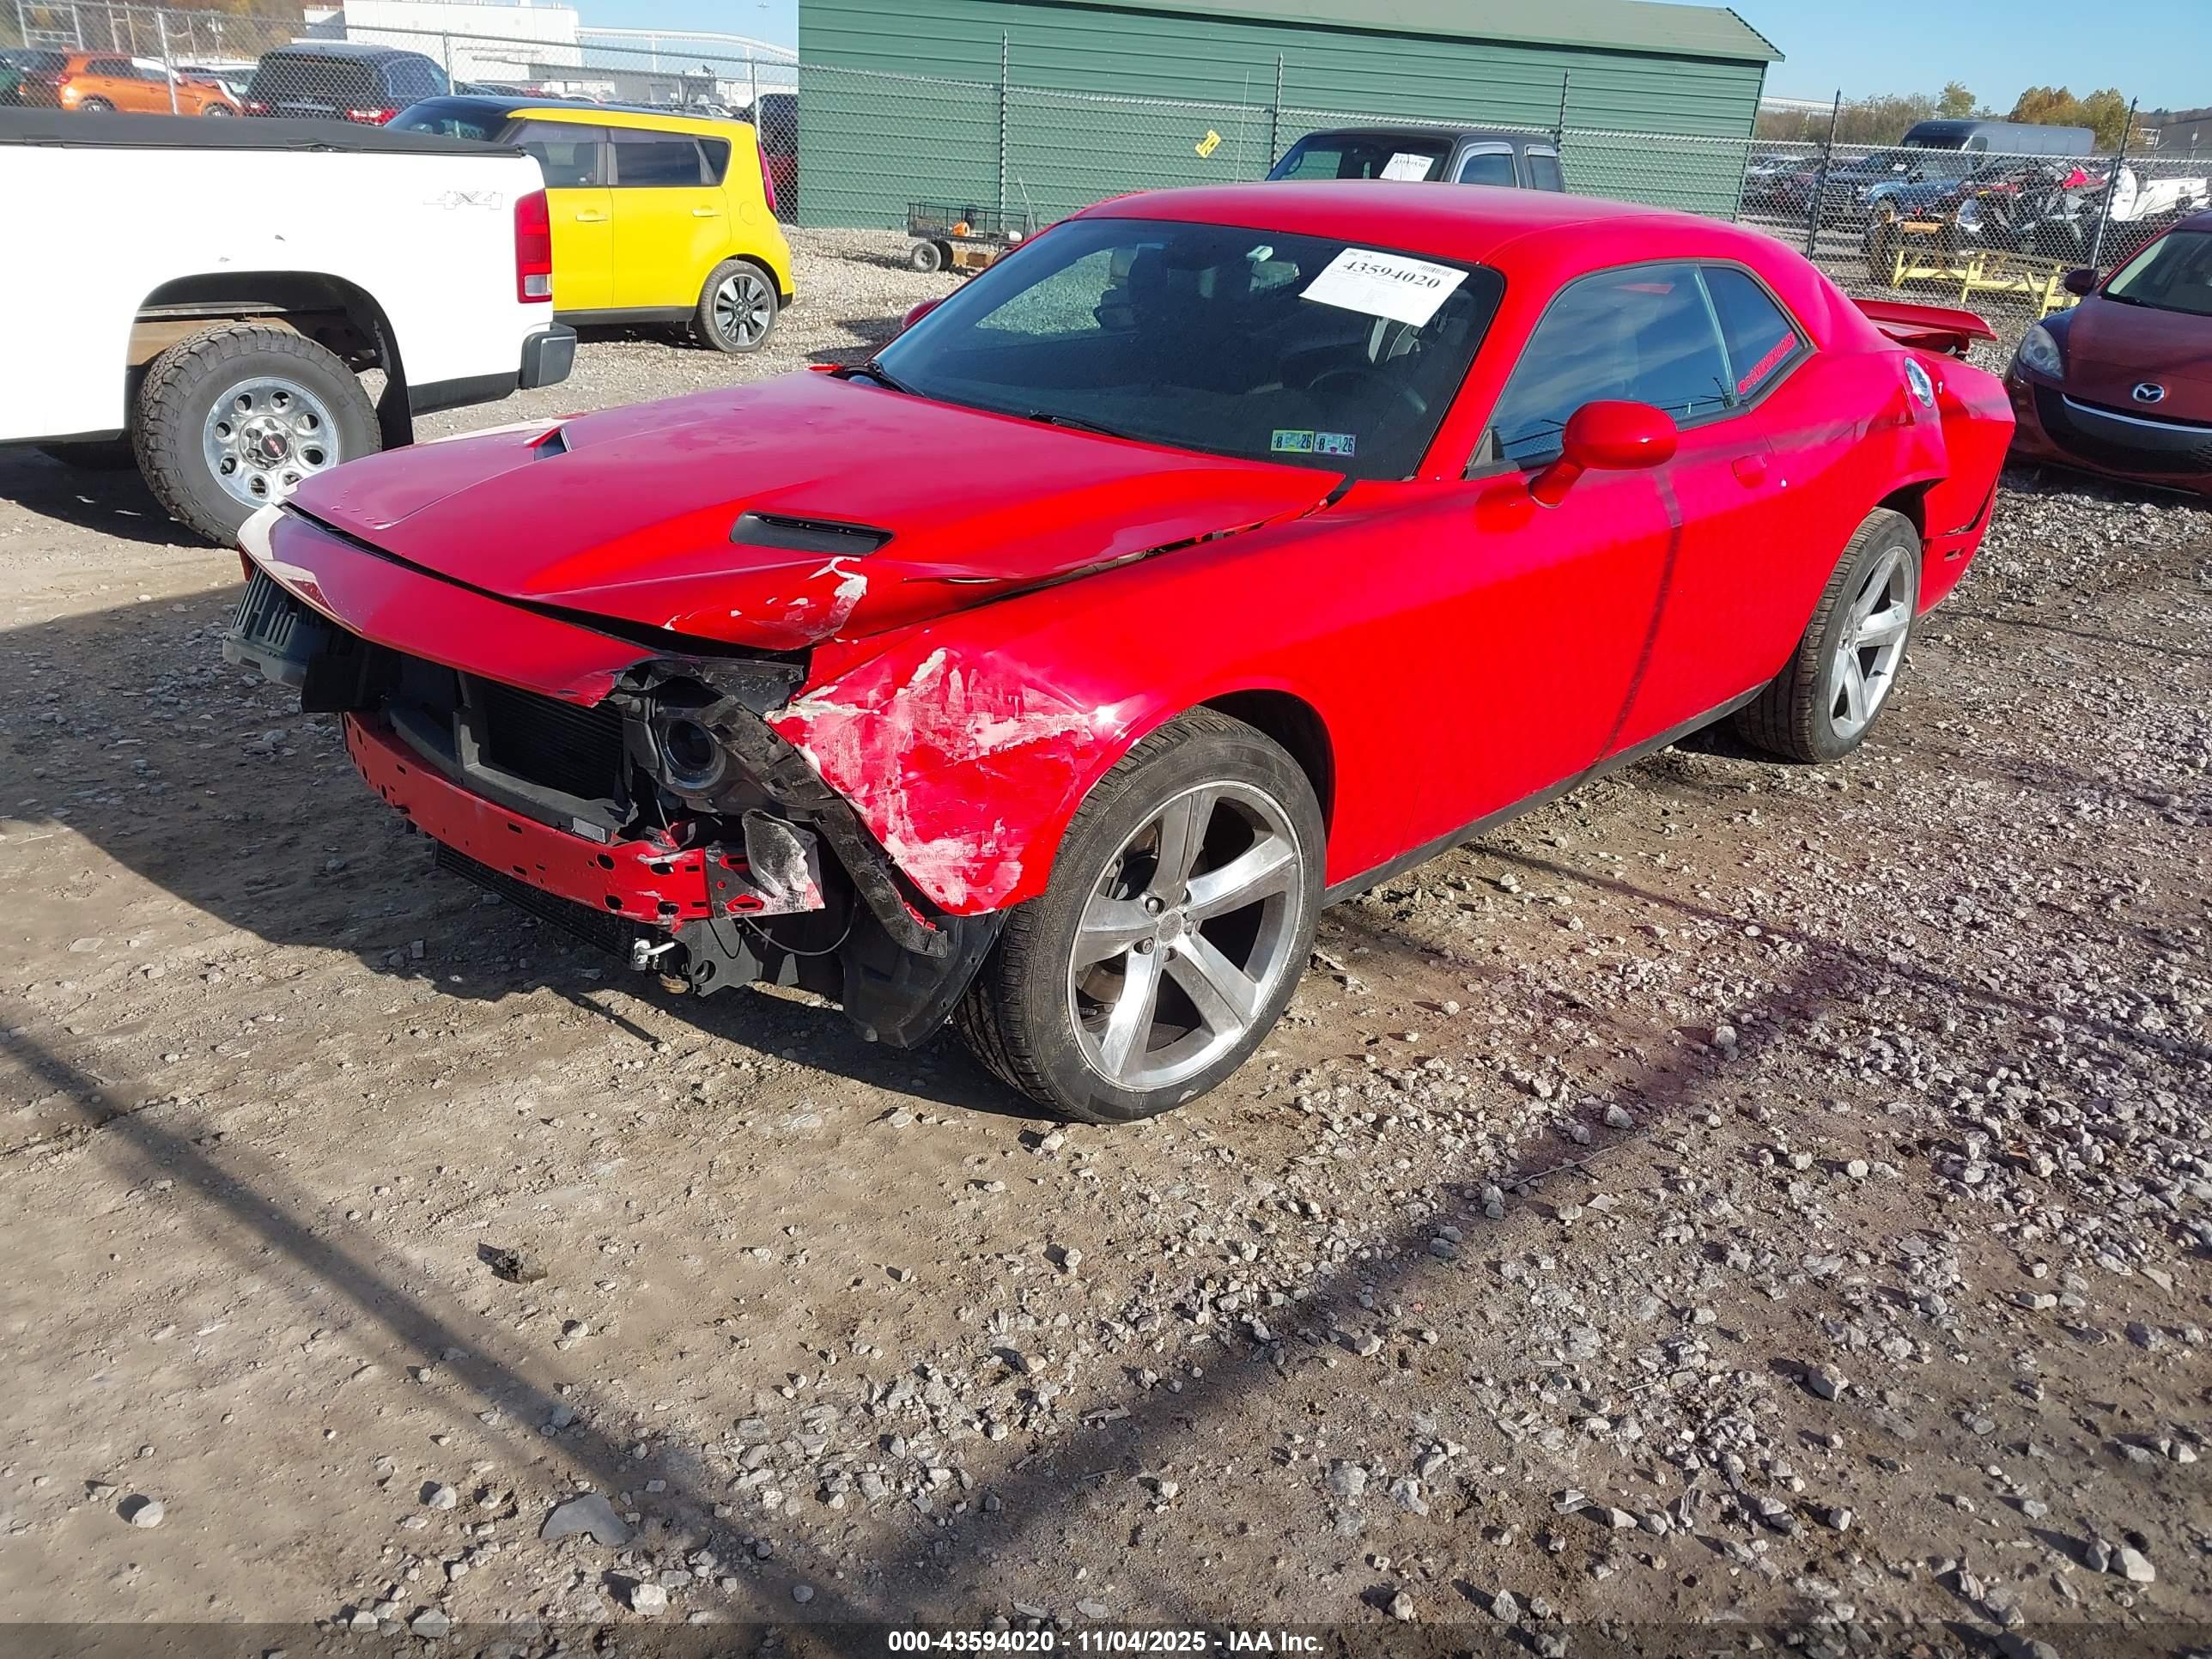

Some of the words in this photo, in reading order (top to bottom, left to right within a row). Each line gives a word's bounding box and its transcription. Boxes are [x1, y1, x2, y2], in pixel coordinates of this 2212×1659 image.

[1343, 260, 1441, 289] 43594020
[1275, 435, 1284, 449] 8
[1300, 434, 1312, 449] 26
[1318, 437, 1326, 452] 8
[1342, 436, 1354, 453] 26
